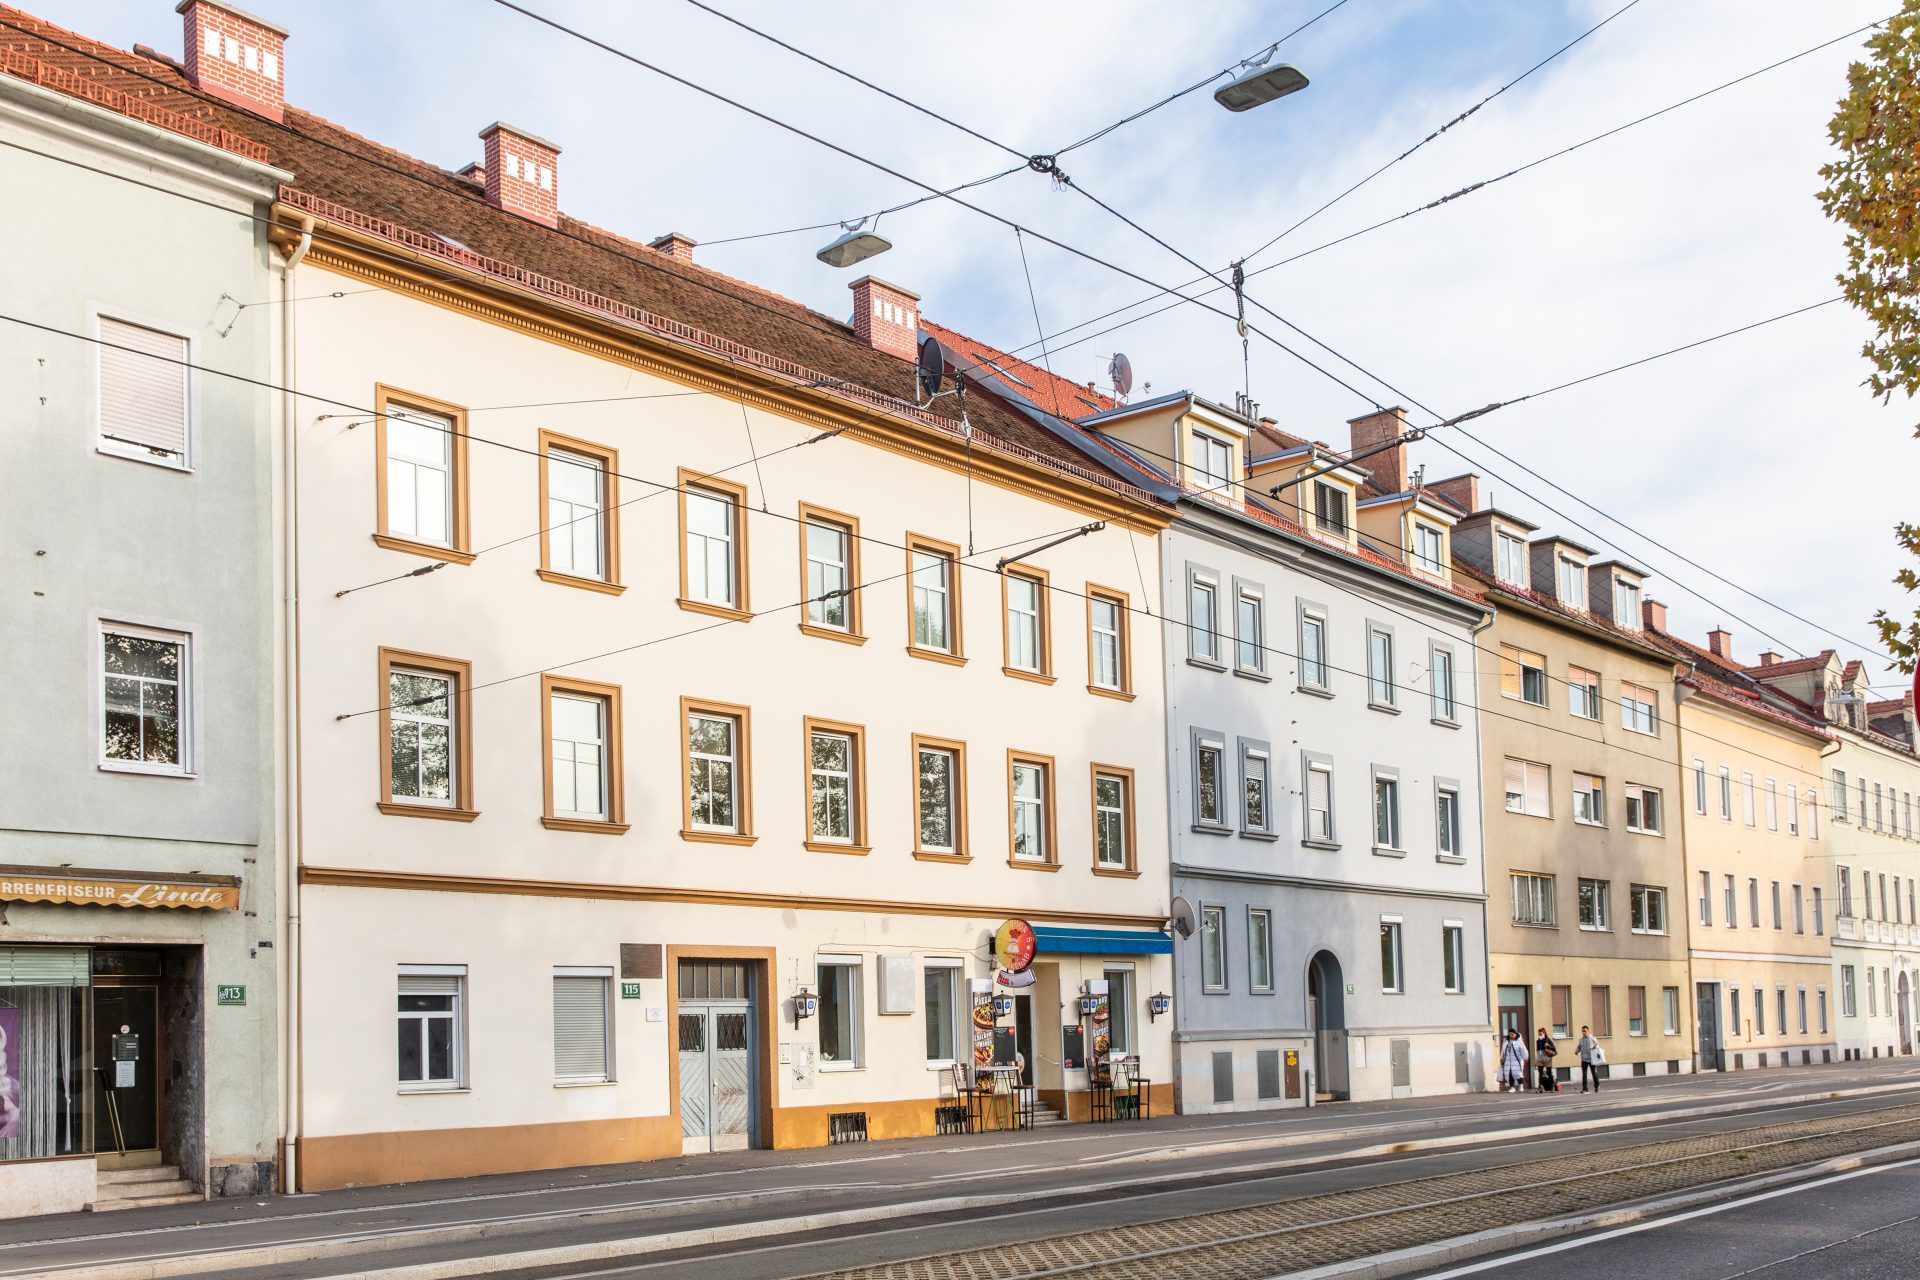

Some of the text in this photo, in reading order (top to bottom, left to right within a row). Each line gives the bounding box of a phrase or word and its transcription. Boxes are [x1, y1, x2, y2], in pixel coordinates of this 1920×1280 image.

[1, 882, 223, 905] RRENFRISEUR Linde
[224, 987, 241, 999] 113
[624, 984, 639, 994] 115
